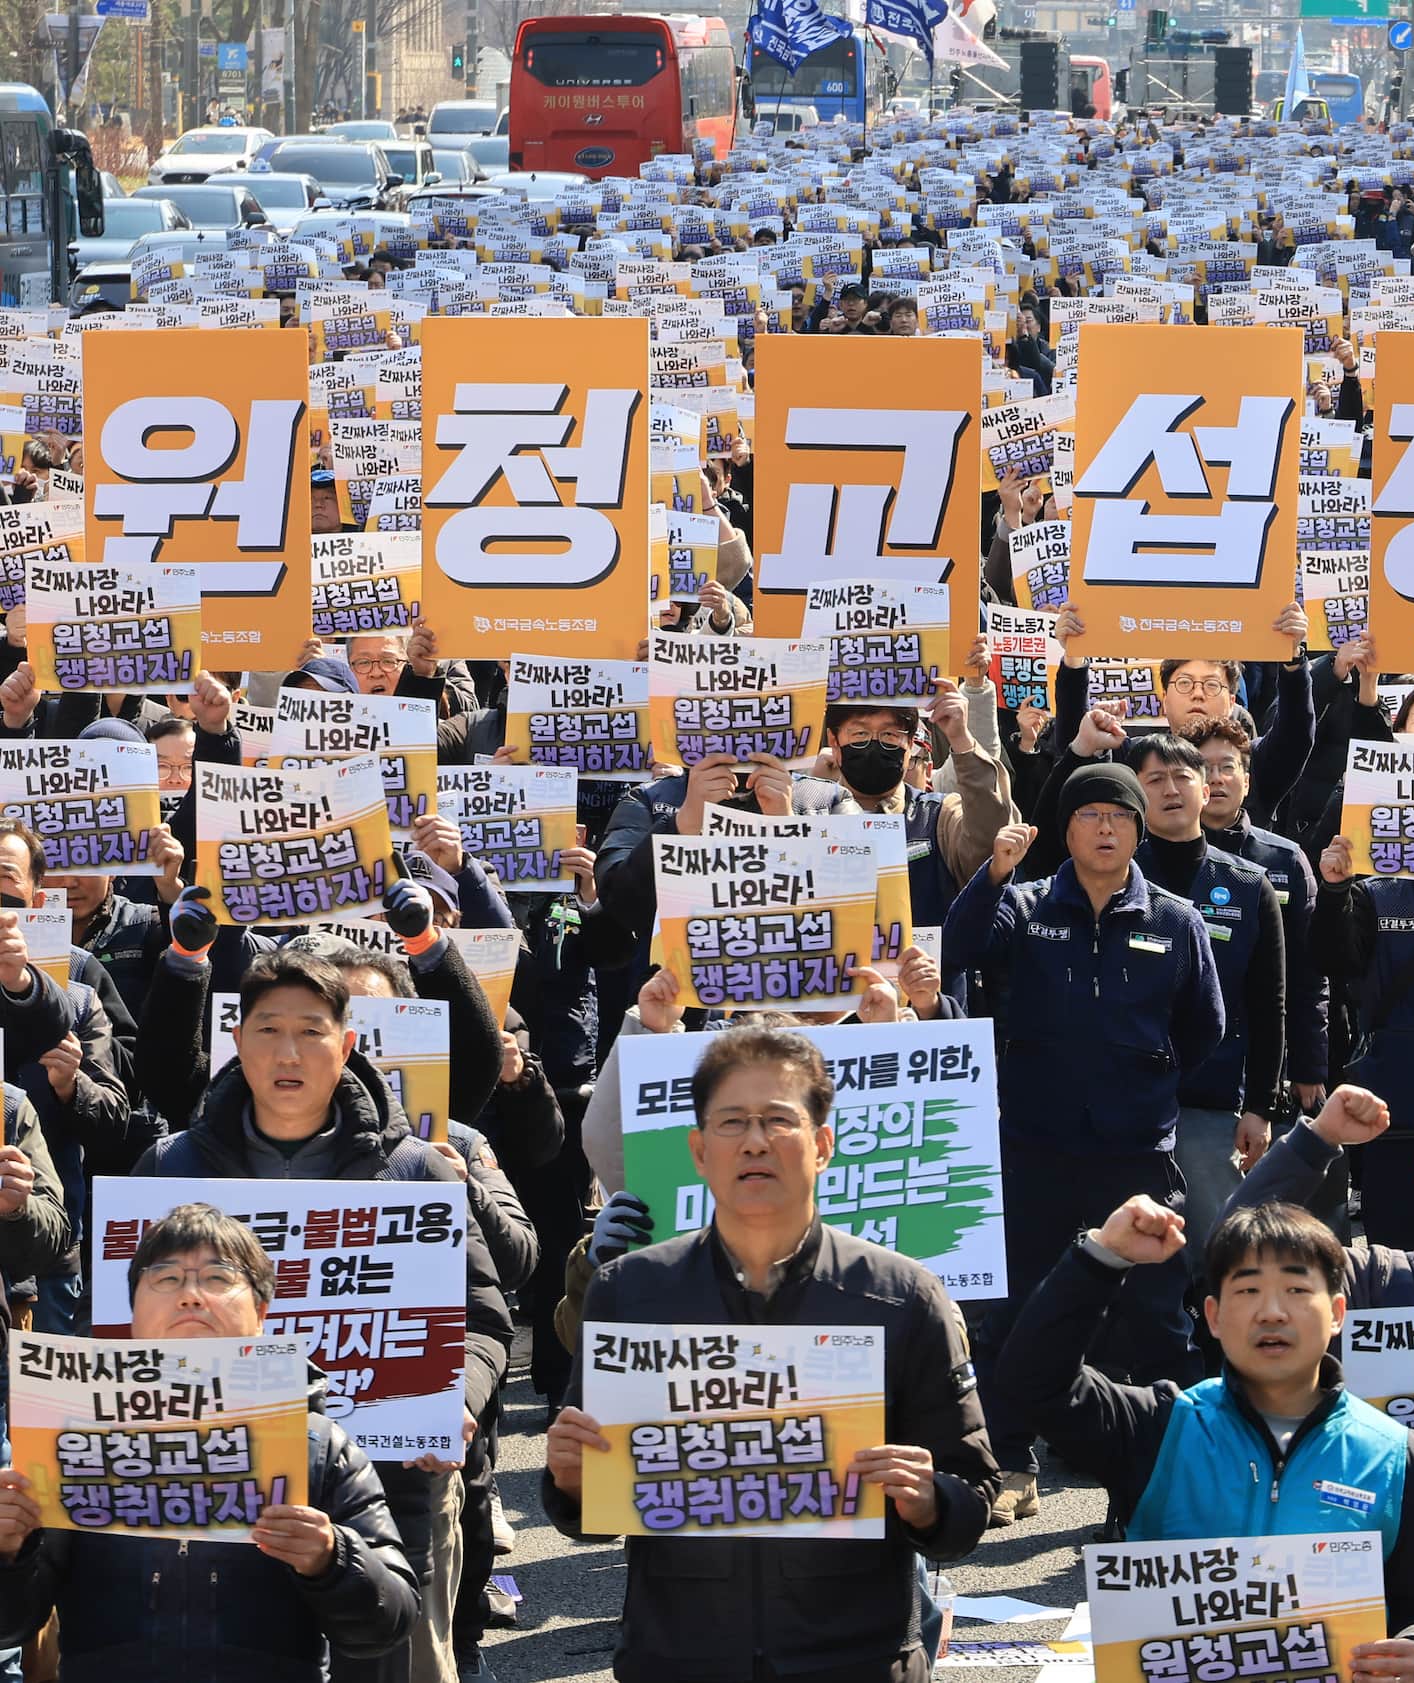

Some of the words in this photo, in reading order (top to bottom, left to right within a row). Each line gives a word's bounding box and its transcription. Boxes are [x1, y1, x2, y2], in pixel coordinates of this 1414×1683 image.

[827, 83, 843, 93] 600
[543, 95, 645, 110] 케이원버스투어
[803, 235, 834, 247] 진짜사장
[618, 264, 655, 275] 진짜사장
[811, 251, 850, 266] 원청교섭
[636, 272, 670, 285] 나와라!
[919, 285, 951, 297] 진짜사장
[1380, 283, 1409, 294] 진짜사장
[200, 303, 239, 317] 진짜사장
[312, 293, 351, 307] 진짜사장
[331, 301, 368, 317] 나와라!
[933, 292, 966, 303] 나와라!
[1088, 303, 1125, 314] 진짜사장
[1258, 293, 1301, 306] 진짜사장
[219, 311, 256, 326] 나와라!
[662, 318, 699, 329] 진짜사장
[926, 303, 973, 319] 원청교섭
[927, 316, 980, 331] 쟁취하자!
[1106, 312, 1139, 324] 나와라!
[1278, 304, 1320, 318] 나와라!
[323, 315, 375, 333] 원청교섭
[679, 326, 715, 339] 나와라!
[324, 329, 387, 349] 쟁취하자!
[94, 397, 308, 596] 원
[424, 384, 643, 589] 청
[1073, 393, 1297, 588] 섭
[758, 408, 971, 595] 교
[30, 566, 119, 591] 진짜사장
[75, 587, 155, 618] 나와라!
[809, 584, 873, 612] 진짜사장
[494, 617, 597, 632] 전국금속노동조합
[835, 604, 907, 631] 나와라!
[1139, 618, 1243, 633] 전국금속노동조합
[53, 617, 172, 654] 원청교섭
[798, 644, 825, 652] 민주노총
[993, 637, 1046, 653] 노동기본권
[654, 638, 741, 666] 진짜사장
[55, 649, 191, 690] 쟁취하자!
[696, 667, 778, 693] 나와라!
[673, 695, 792, 730] 원청교섭
[25, 764, 109, 796] 나와라!
[200, 771, 284, 803] 진짜사장
[239, 796, 333, 835] 나와라!
[873, 820, 900, 830] 민주노총
[218, 828, 359, 881] 원청교섭
[660, 844, 768, 876] 진짜사장
[839, 844, 871, 855] 민주노총
[221, 862, 386, 921] 쟁취하자!
[712, 871, 815, 909] 나와라!
[686, 911, 833, 960] 원청교섭
[1029, 923, 1070, 939] 단결투쟁
[692, 953, 856, 1005] 쟁취하자!
[408, 1005, 442, 1017] 민주노총
[907, 1044, 980, 1083] 위한,
[818, 1157, 950, 1216] 만드는
[320, 1254, 395, 1296] 없는
[593, 1333, 739, 1374] 진짜사장
[831, 1335, 875, 1347] 민주노총
[18, 1341, 164, 1384] 진짜사장
[93, 1377, 224, 1423] 나와라!
[668, 1365, 799, 1413] 나와라!
[56, 1425, 251, 1479] 원청교섭
[355, 1435, 451, 1449] 전국건설노동조합
[630, 1414, 827, 1474] 원청교섭
[61, 1477, 288, 1529] 쟁취하자!
[633, 1469, 864, 1531] 쟁취하자!
[1328, 1540, 1372, 1553] 민주노총
[1095, 1546, 1239, 1591] 진짜사장
[1172, 1574, 1301, 1626] 나와라!
[1140, 1621, 1331, 1683] 원청교섭
